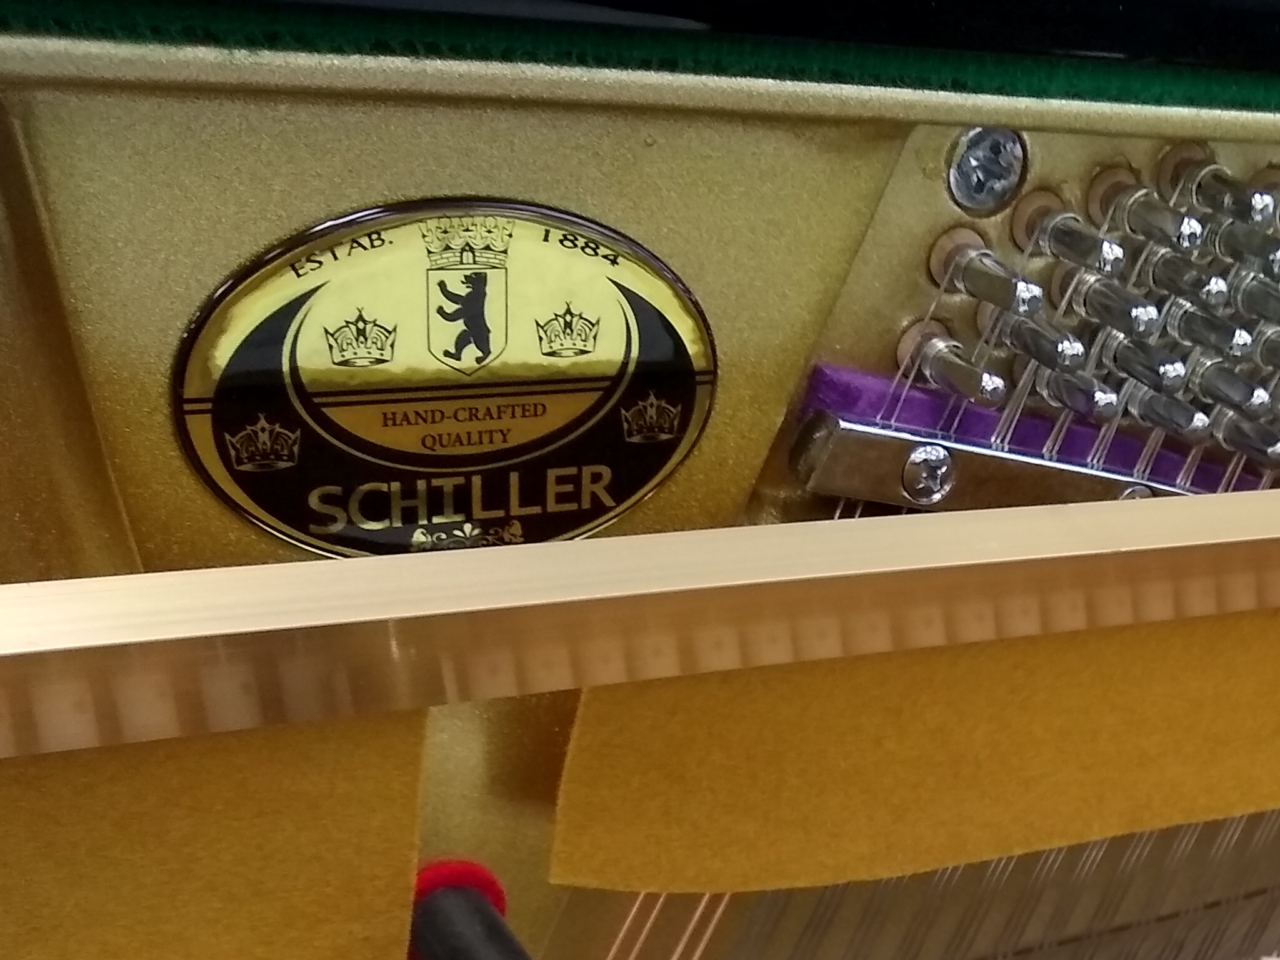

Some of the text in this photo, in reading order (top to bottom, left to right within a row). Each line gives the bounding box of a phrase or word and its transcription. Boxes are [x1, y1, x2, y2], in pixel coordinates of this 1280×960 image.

[288, 228, 621, 280] ESTAB. 1884
[381, 402, 548, 428] HAND-CRAFTED
[420, 428, 512, 452] QUALITY
[307, 464, 617, 535] SCHILLER
